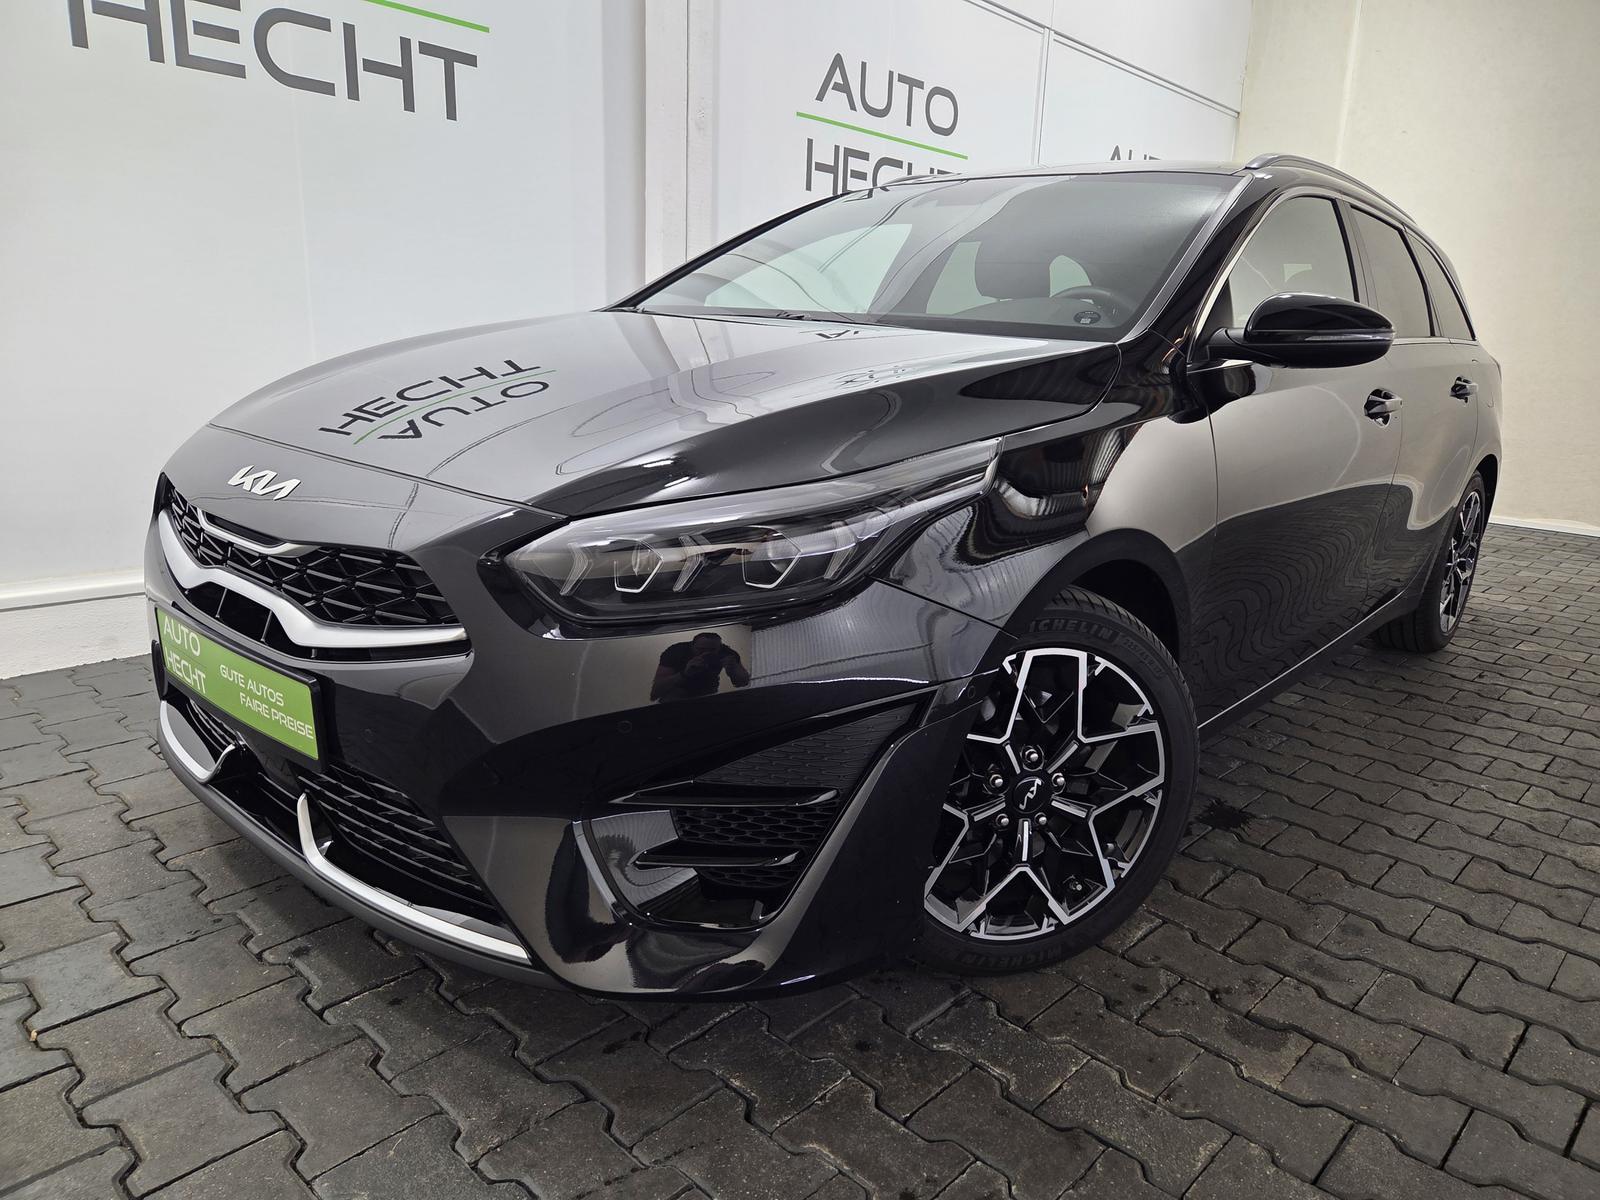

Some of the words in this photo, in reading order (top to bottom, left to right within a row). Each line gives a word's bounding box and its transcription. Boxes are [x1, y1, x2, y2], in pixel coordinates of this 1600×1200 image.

[815, 52, 959, 136] AUTO
[163, 615, 201, 657] AUTO
[164, 646, 206, 694] HECHT
[220, 664, 245, 688] GUTE
[247, 679, 285, 707] AUTOS
[240, 692, 270, 718] FAIRE
[271, 707, 314, 739] PREISE
